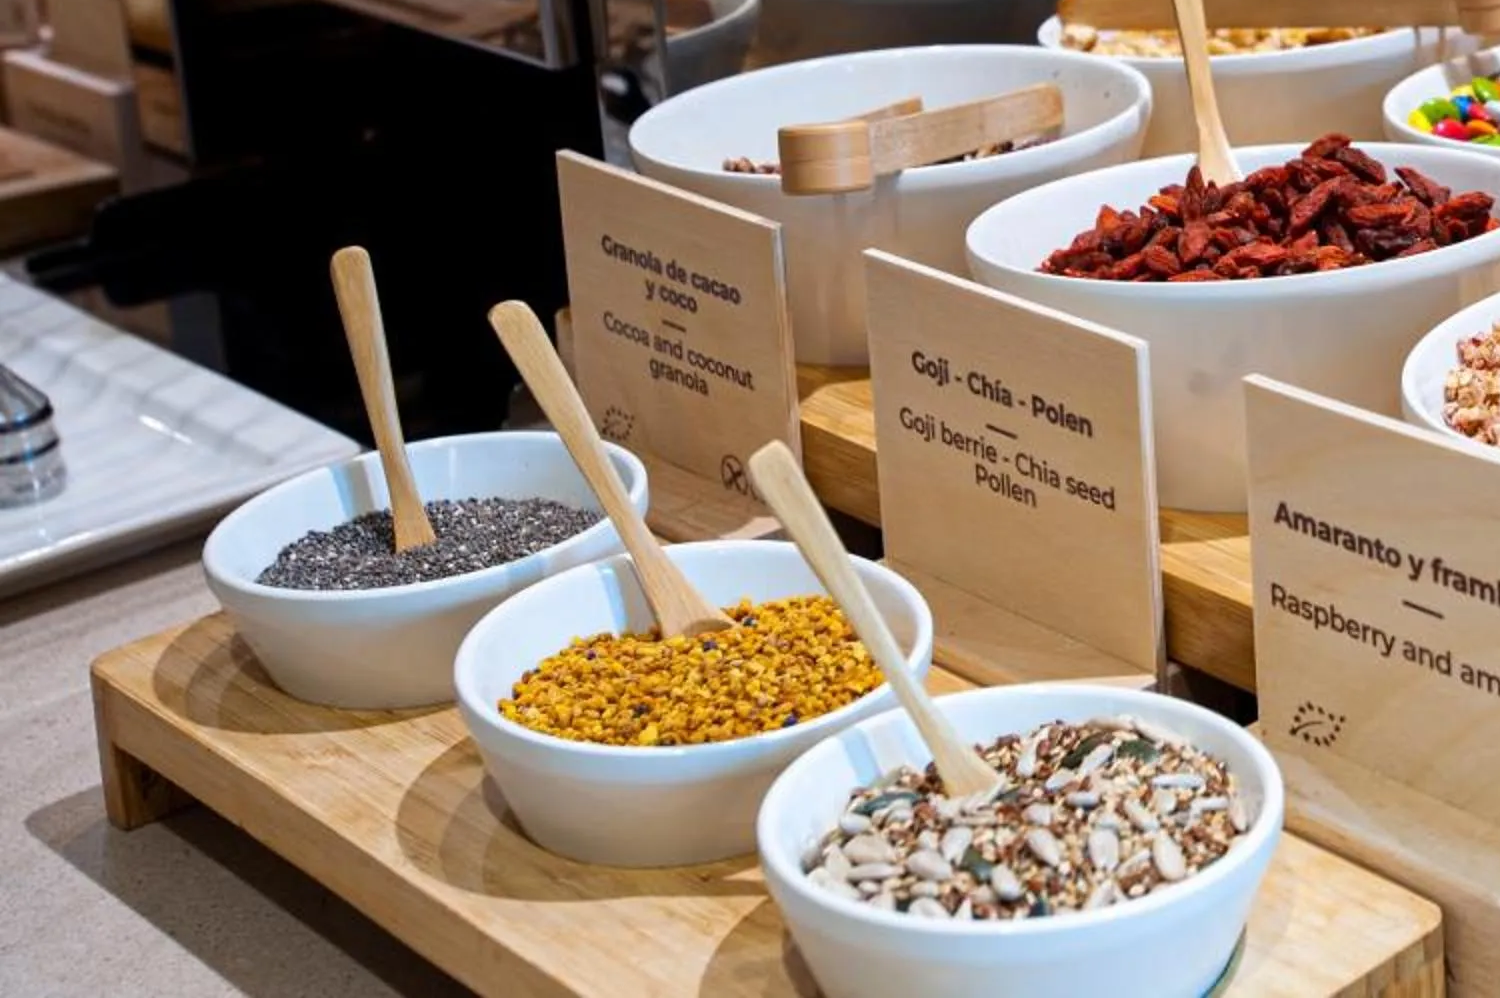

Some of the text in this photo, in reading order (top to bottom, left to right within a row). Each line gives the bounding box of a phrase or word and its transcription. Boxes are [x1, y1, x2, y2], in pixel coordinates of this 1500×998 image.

[601, 233, 741, 306] Granola de cacao
[645, 280, 698, 314] y coco
[603, 311, 755, 392] Cocoa and coconut
[649, 358, 710, 397] granola
[911, 351, 951, 386] Goji
[1031, 394, 1093, 438] Polen
[900, 407, 936, 442] Goji
[940, 421, 998, 464] berrie
[1015, 453, 1061, 489] Chia
[1065, 474, 1116, 511] seed
[975, 464, 1037, 508] Pollen
[1273, 501, 1402, 569] Amaranto
[1408, 553, 1424, 581] y
[1270, 582, 1396, 658] Raspberry
[1402, 638, 1453, 677] and
